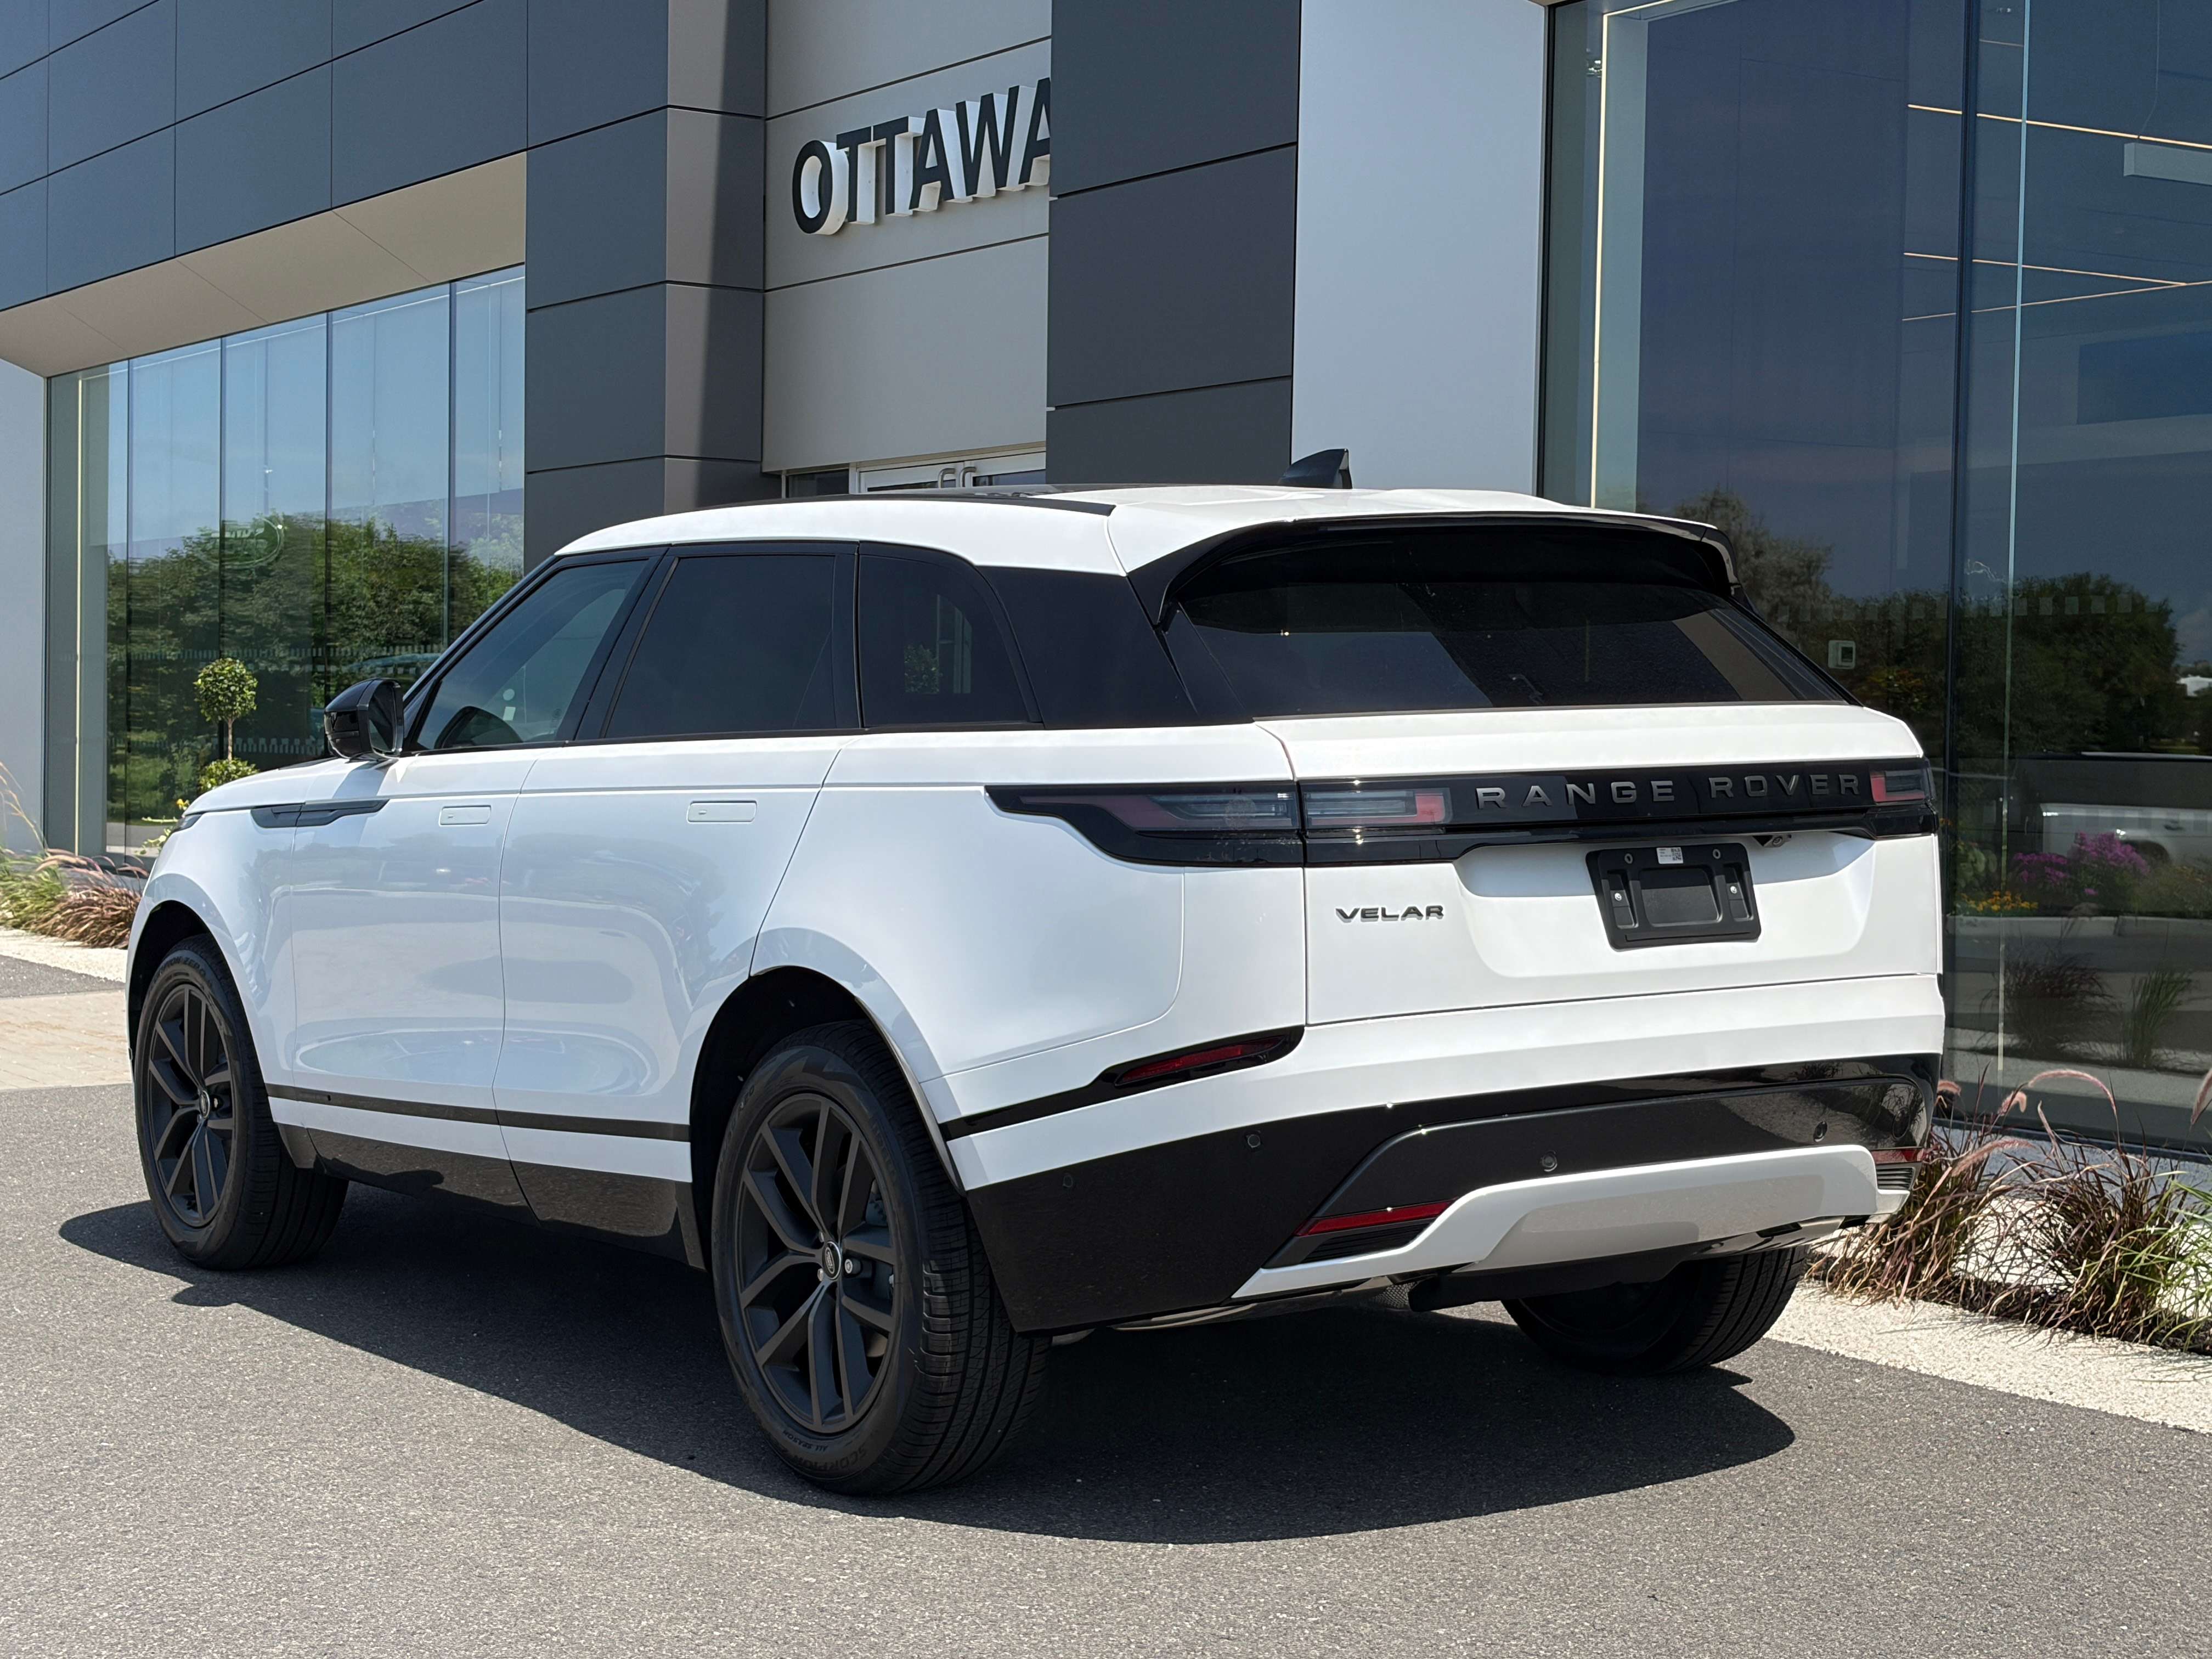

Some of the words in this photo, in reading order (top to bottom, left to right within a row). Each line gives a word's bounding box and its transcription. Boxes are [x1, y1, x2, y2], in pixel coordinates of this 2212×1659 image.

[792, 77, 1051, 235] OTTAWA
[1475, 780, 1675, 810] RANGE
[1708, 774, 1860, 799] ROVER
[1335, 905, 1444, 923] VELAR
